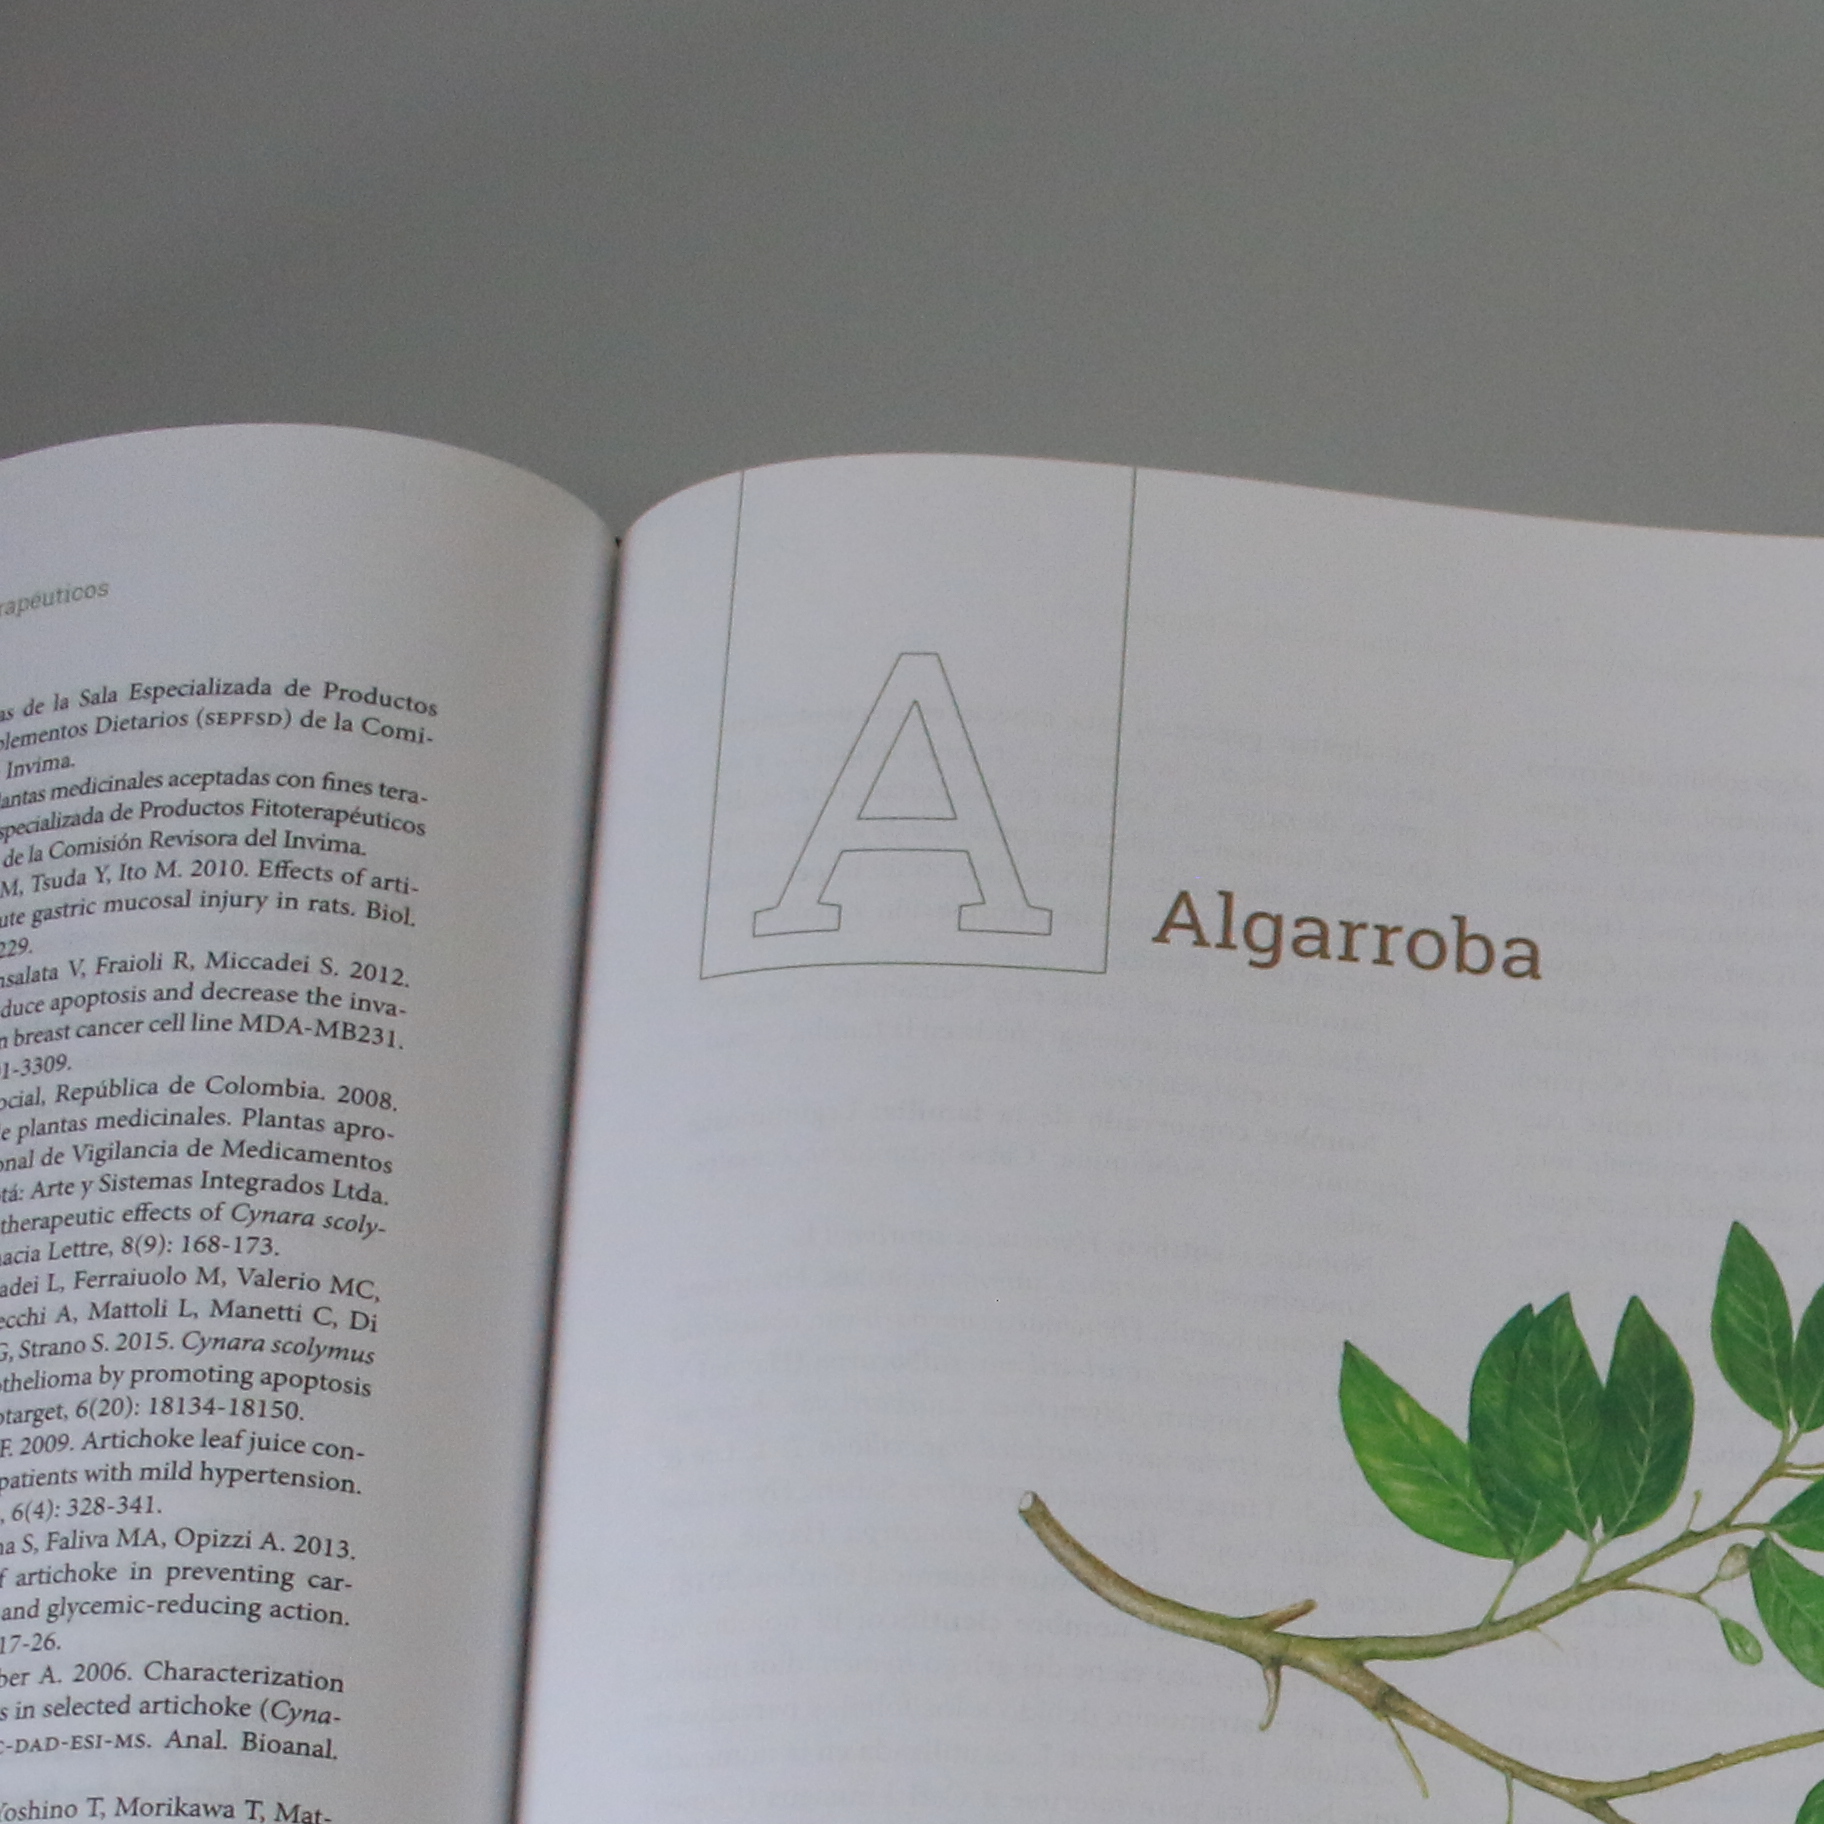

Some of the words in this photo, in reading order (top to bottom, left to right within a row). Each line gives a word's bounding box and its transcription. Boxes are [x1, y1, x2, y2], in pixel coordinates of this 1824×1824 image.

[21, 697, 46, 718] de
[52, 692, 70, 712] la
[78, 685, 118, 709] Sala
[128, 676, 273, 705] Especializada
[283, 677, 312, 699] de
[322, 680, 439, 718] Productos
[94, 711, 189, 736] Dietarios
[298, 708, 328, 730] de
[333, 711, 354, 733] la
[360, 716, 434, 745] Comi-
[752, 650, 1055, 940] A
[108, 802, 134, 823] de
[138, 797, 245, 820] Productos
[250, 798, 427, 837] Fitoterapéuticos
[1, 847, 25, 869] de
[27, 844, 44, 865] la
[47, 832, 143, 861] Comisión
[148, 829, 239, 850] Revisora
[243, 826, 278, 848] del
[283, 829, 367, 857] Invima.
[1151, 889, 1542, 981] Algarroba
[94, 951, 163, 976] Fraioli
[172, 950, 196, 972] R,
[204, 950, 310, 974] Miccadei
[319, 956, 339, 977] S.
[349, 960, 410, 989] 2012.
[12, 1023, 72, 1048] breast
[74, 1019, 145, 1039] cancer
[147, 1011, 186, 1034] cell
[190, 1010, 234, 1033] line
[238, 1012, 404, 1051] MDA-MB231.
[54, 1076, 159, 1107] República
[167, 1074, 196, 1095] de
[204, 1074, 326, 1102] Colombia.
[336, 1084, 398, 1113] 2008.
[0, 1208, 115, 1236] therapeutic
[121, 1201, 192, 1224] effects
[198, 1200, 227, 1222] of
[230, 1202, 316, 1229] Cynara
[322, 1213, 386, 1241] scoly-
[18, 1432, 75, 1457] 2009.
[81, 1426, 195, 1451] Artichoke
[199, 1427, 247, 1450] leaf
[246, 1431, 307, 1456] juice
[311, 1441, 365, 1461] con-
[83, 1460, 133, 1483] with
[138, 1459, 193, 1482] mild
[199, 1460, 362, 1496] hypertension.
[0, 1597, 41, 1622] and
[45, 1592, 263, 1625] glycemic-reducing
[268, 1602, 350, 1627] action.
[38, 1664, 62, 1685] A.
[72, 1661, 133, 1684] 2006.
[143, 1659, 345, 1695] Characterization
